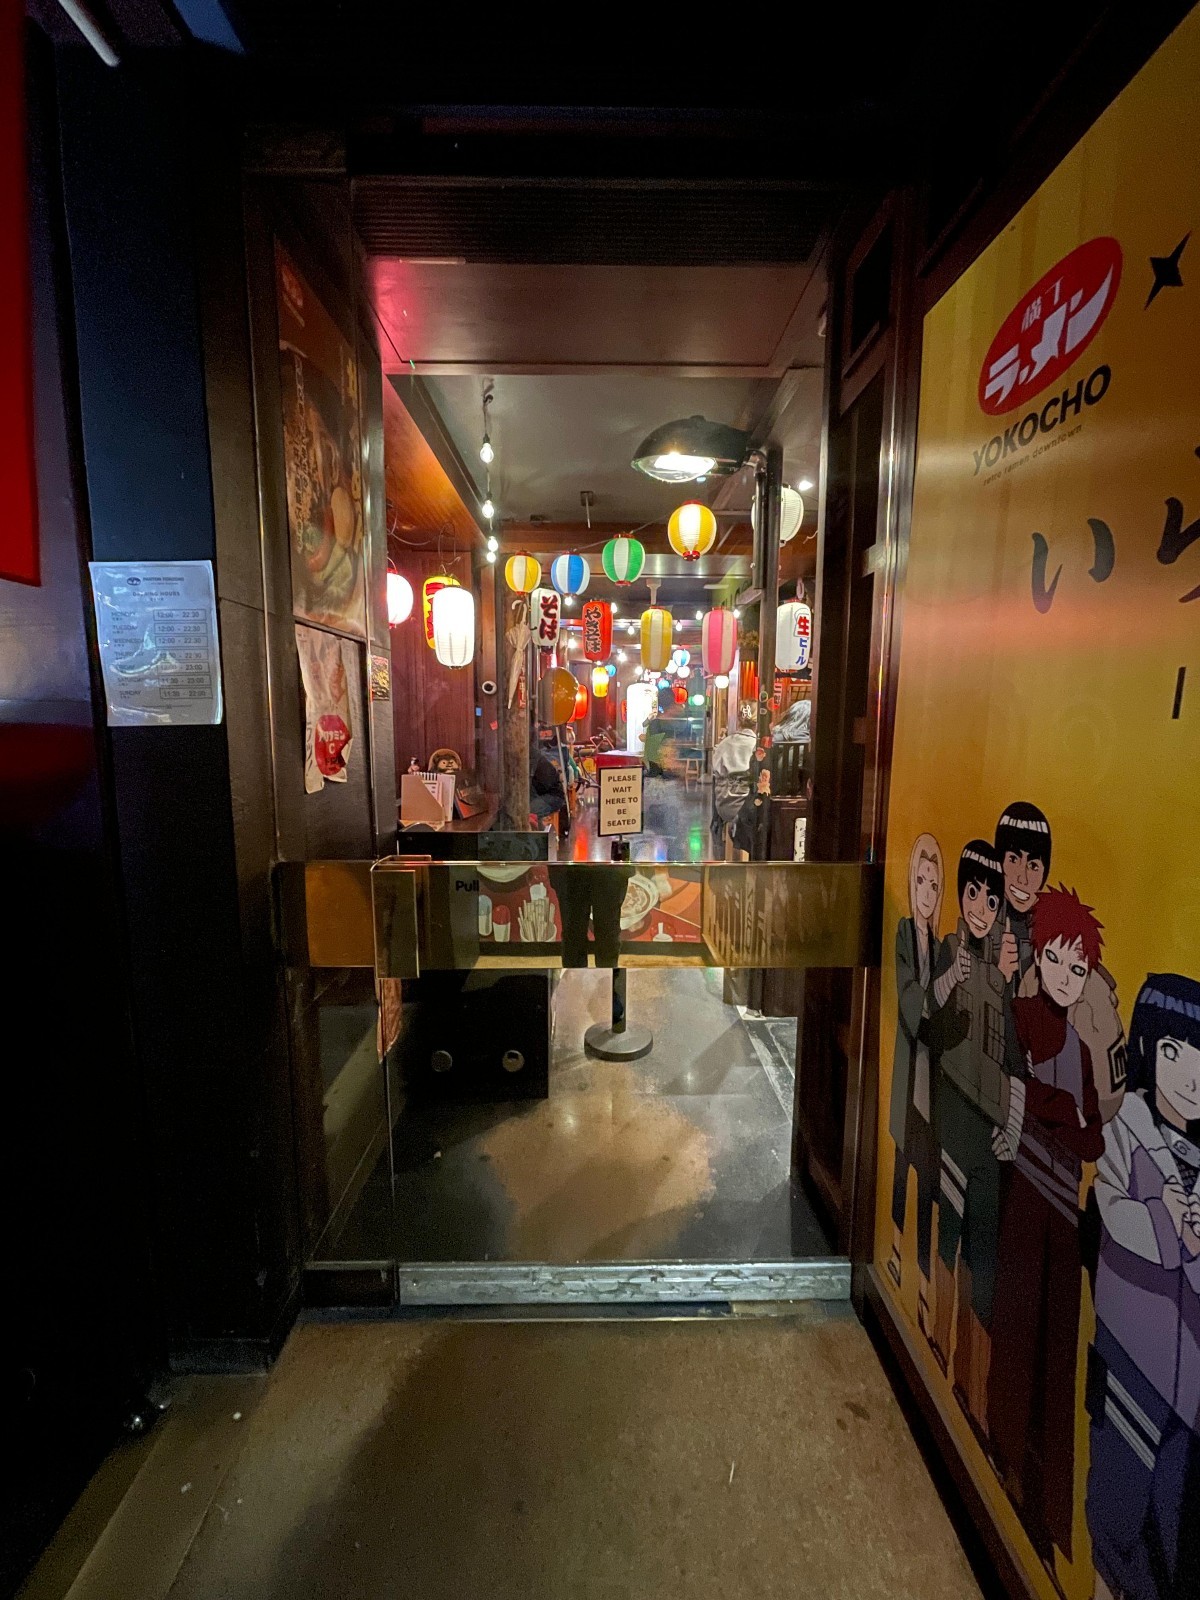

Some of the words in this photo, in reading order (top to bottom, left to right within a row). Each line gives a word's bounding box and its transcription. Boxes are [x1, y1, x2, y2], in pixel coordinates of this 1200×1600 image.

[972, 363, 1112, 477] YOKOCHO
[1004, 453, 1030, 475] ramen
[1032, 424, 1083, 459] downtown
[539, 594, 558, 641] そば
[584, 606, 603, 653] やきそば
[607, 774, 637, 782] PLEASE
[605, 797, 626, 805] HERE
[606, 818, 637, 827] SEATED
[455, 879, 480, 892] Pull
